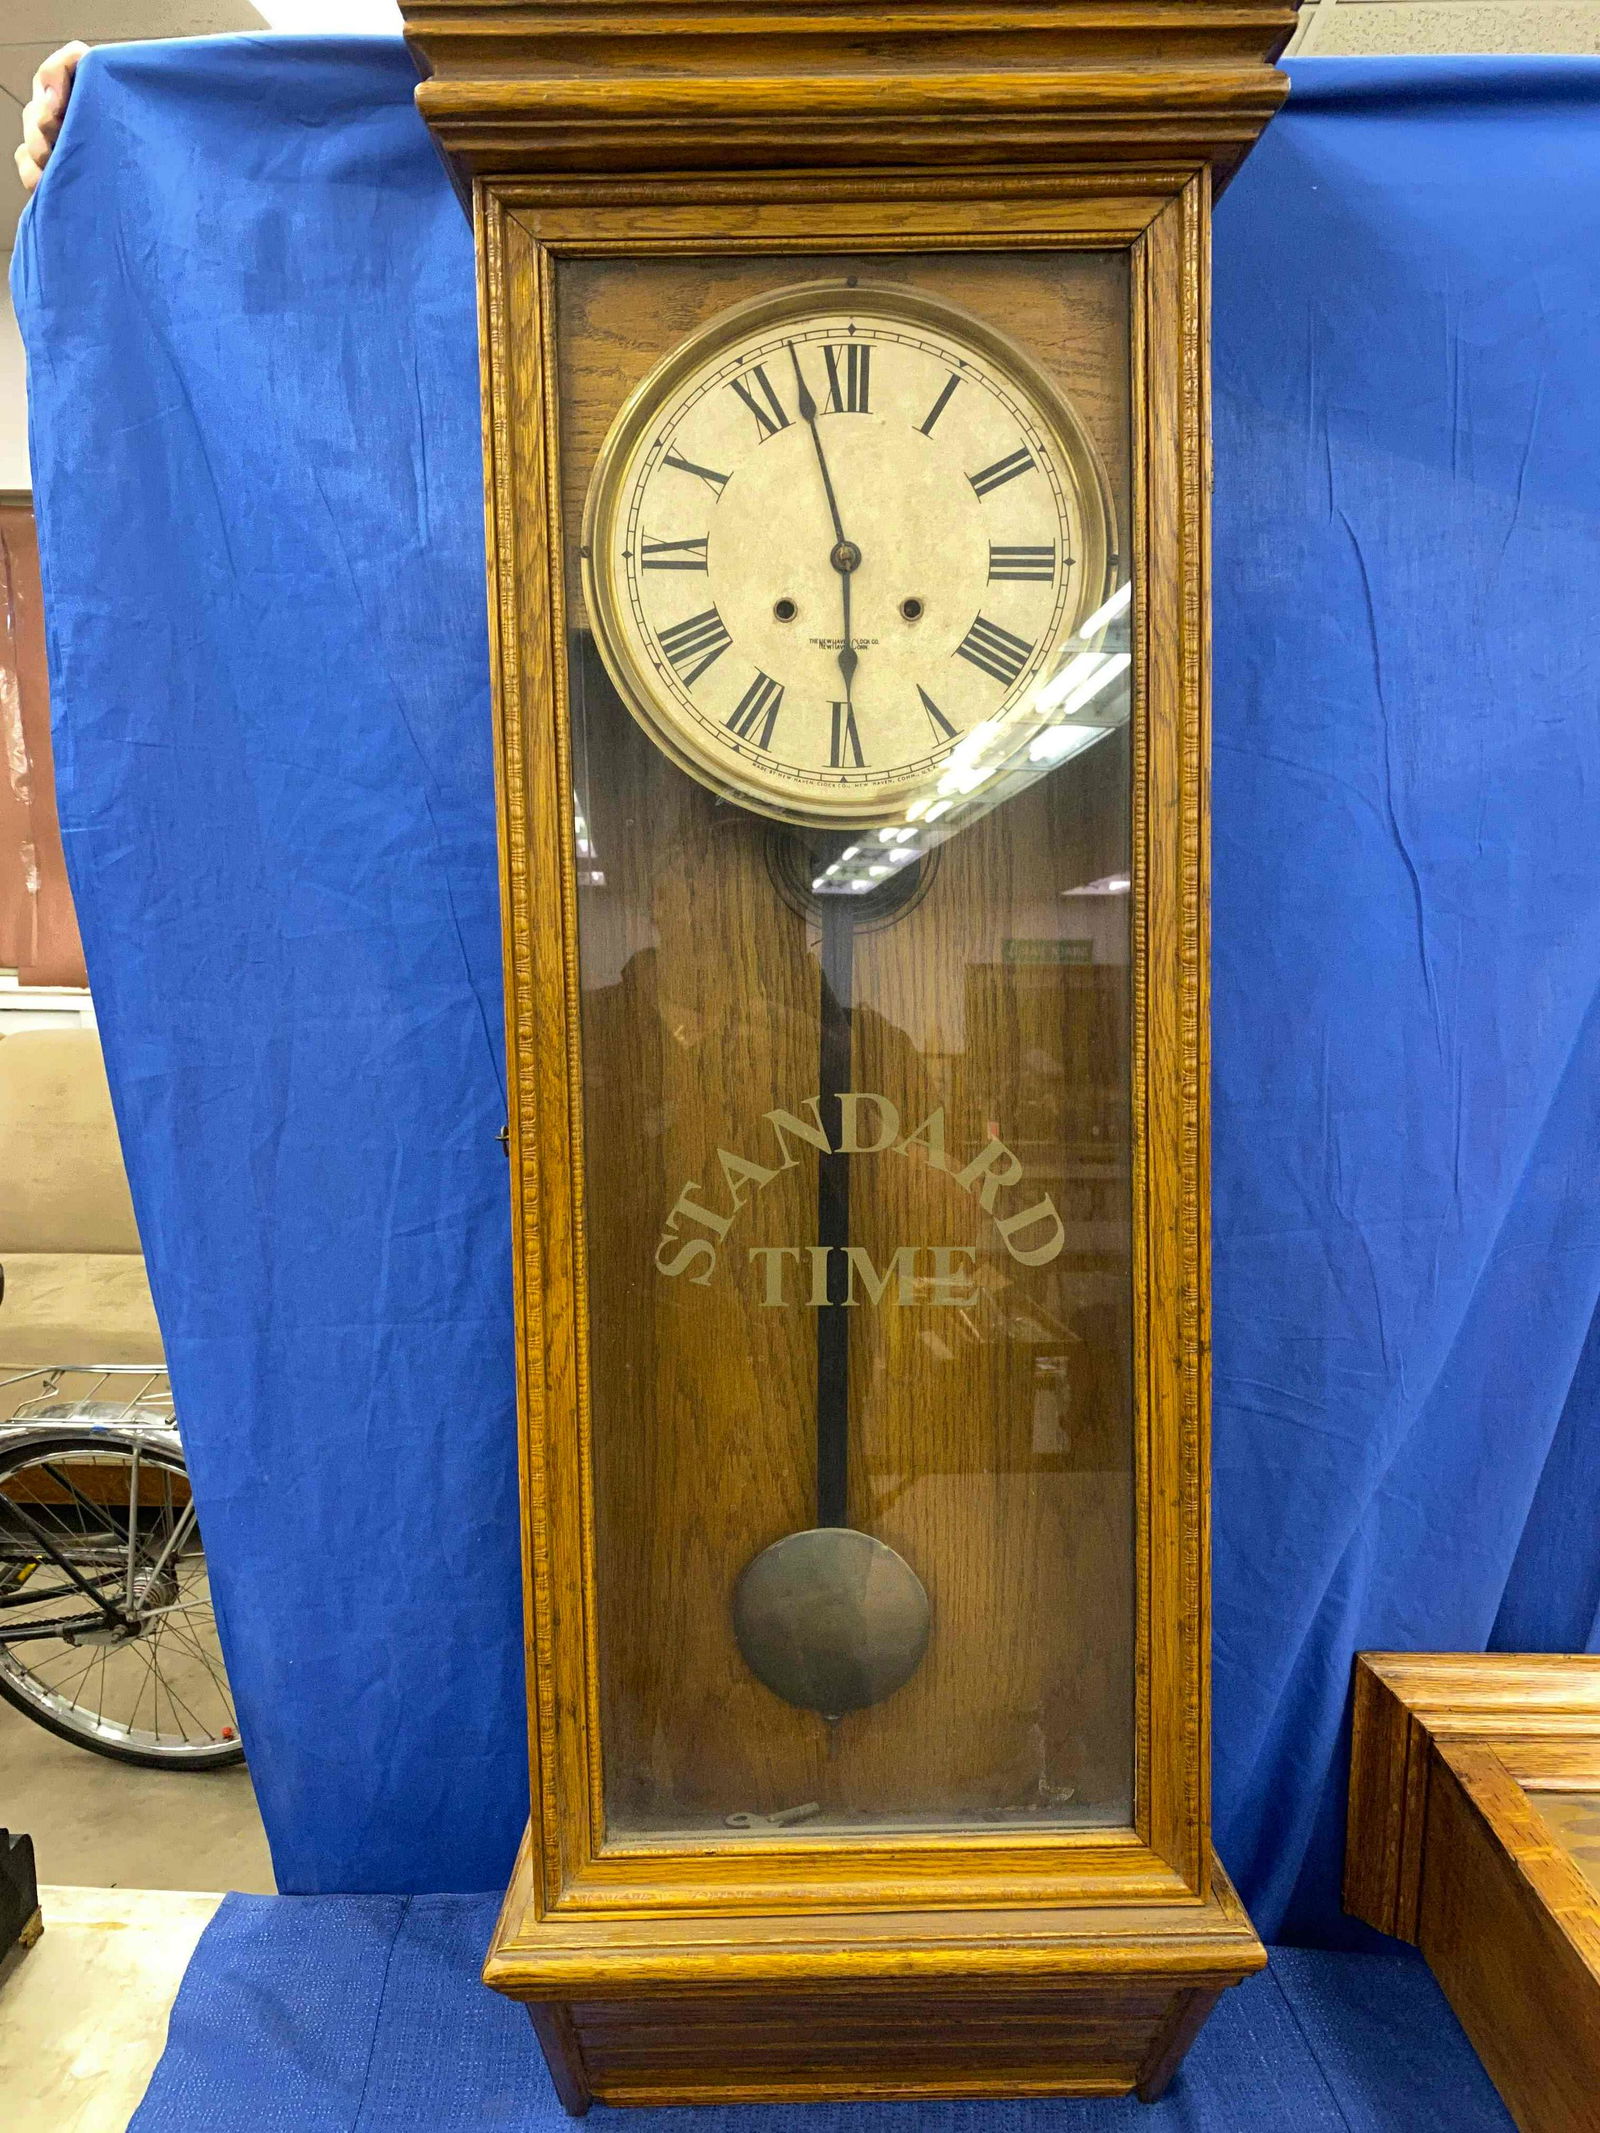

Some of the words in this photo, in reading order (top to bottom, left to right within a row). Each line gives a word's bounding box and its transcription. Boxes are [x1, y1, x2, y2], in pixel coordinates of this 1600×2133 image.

[724, 361, 796, 445] XI
[820, 344, 876, 415] XII
[913, 368, 969, 440] I
[658, 438, 734, 504] X
[964, 438, 1039, 504] II
[641, 526, 709, 577] IX
[987, 538, 1056, 588] III
[654, 601, 734, 694] VIII
[720, 666, 784, 752] VII
[822, 700, 872, 768] VI
[916, 683, 964, 749] V
[752, 762, 767, 772] MADE
[794, 777, 814, 785] HAVEN
[654, 1092, 1066, 1287] STANDARD
[748, 1245, 979, 1307] TIME
